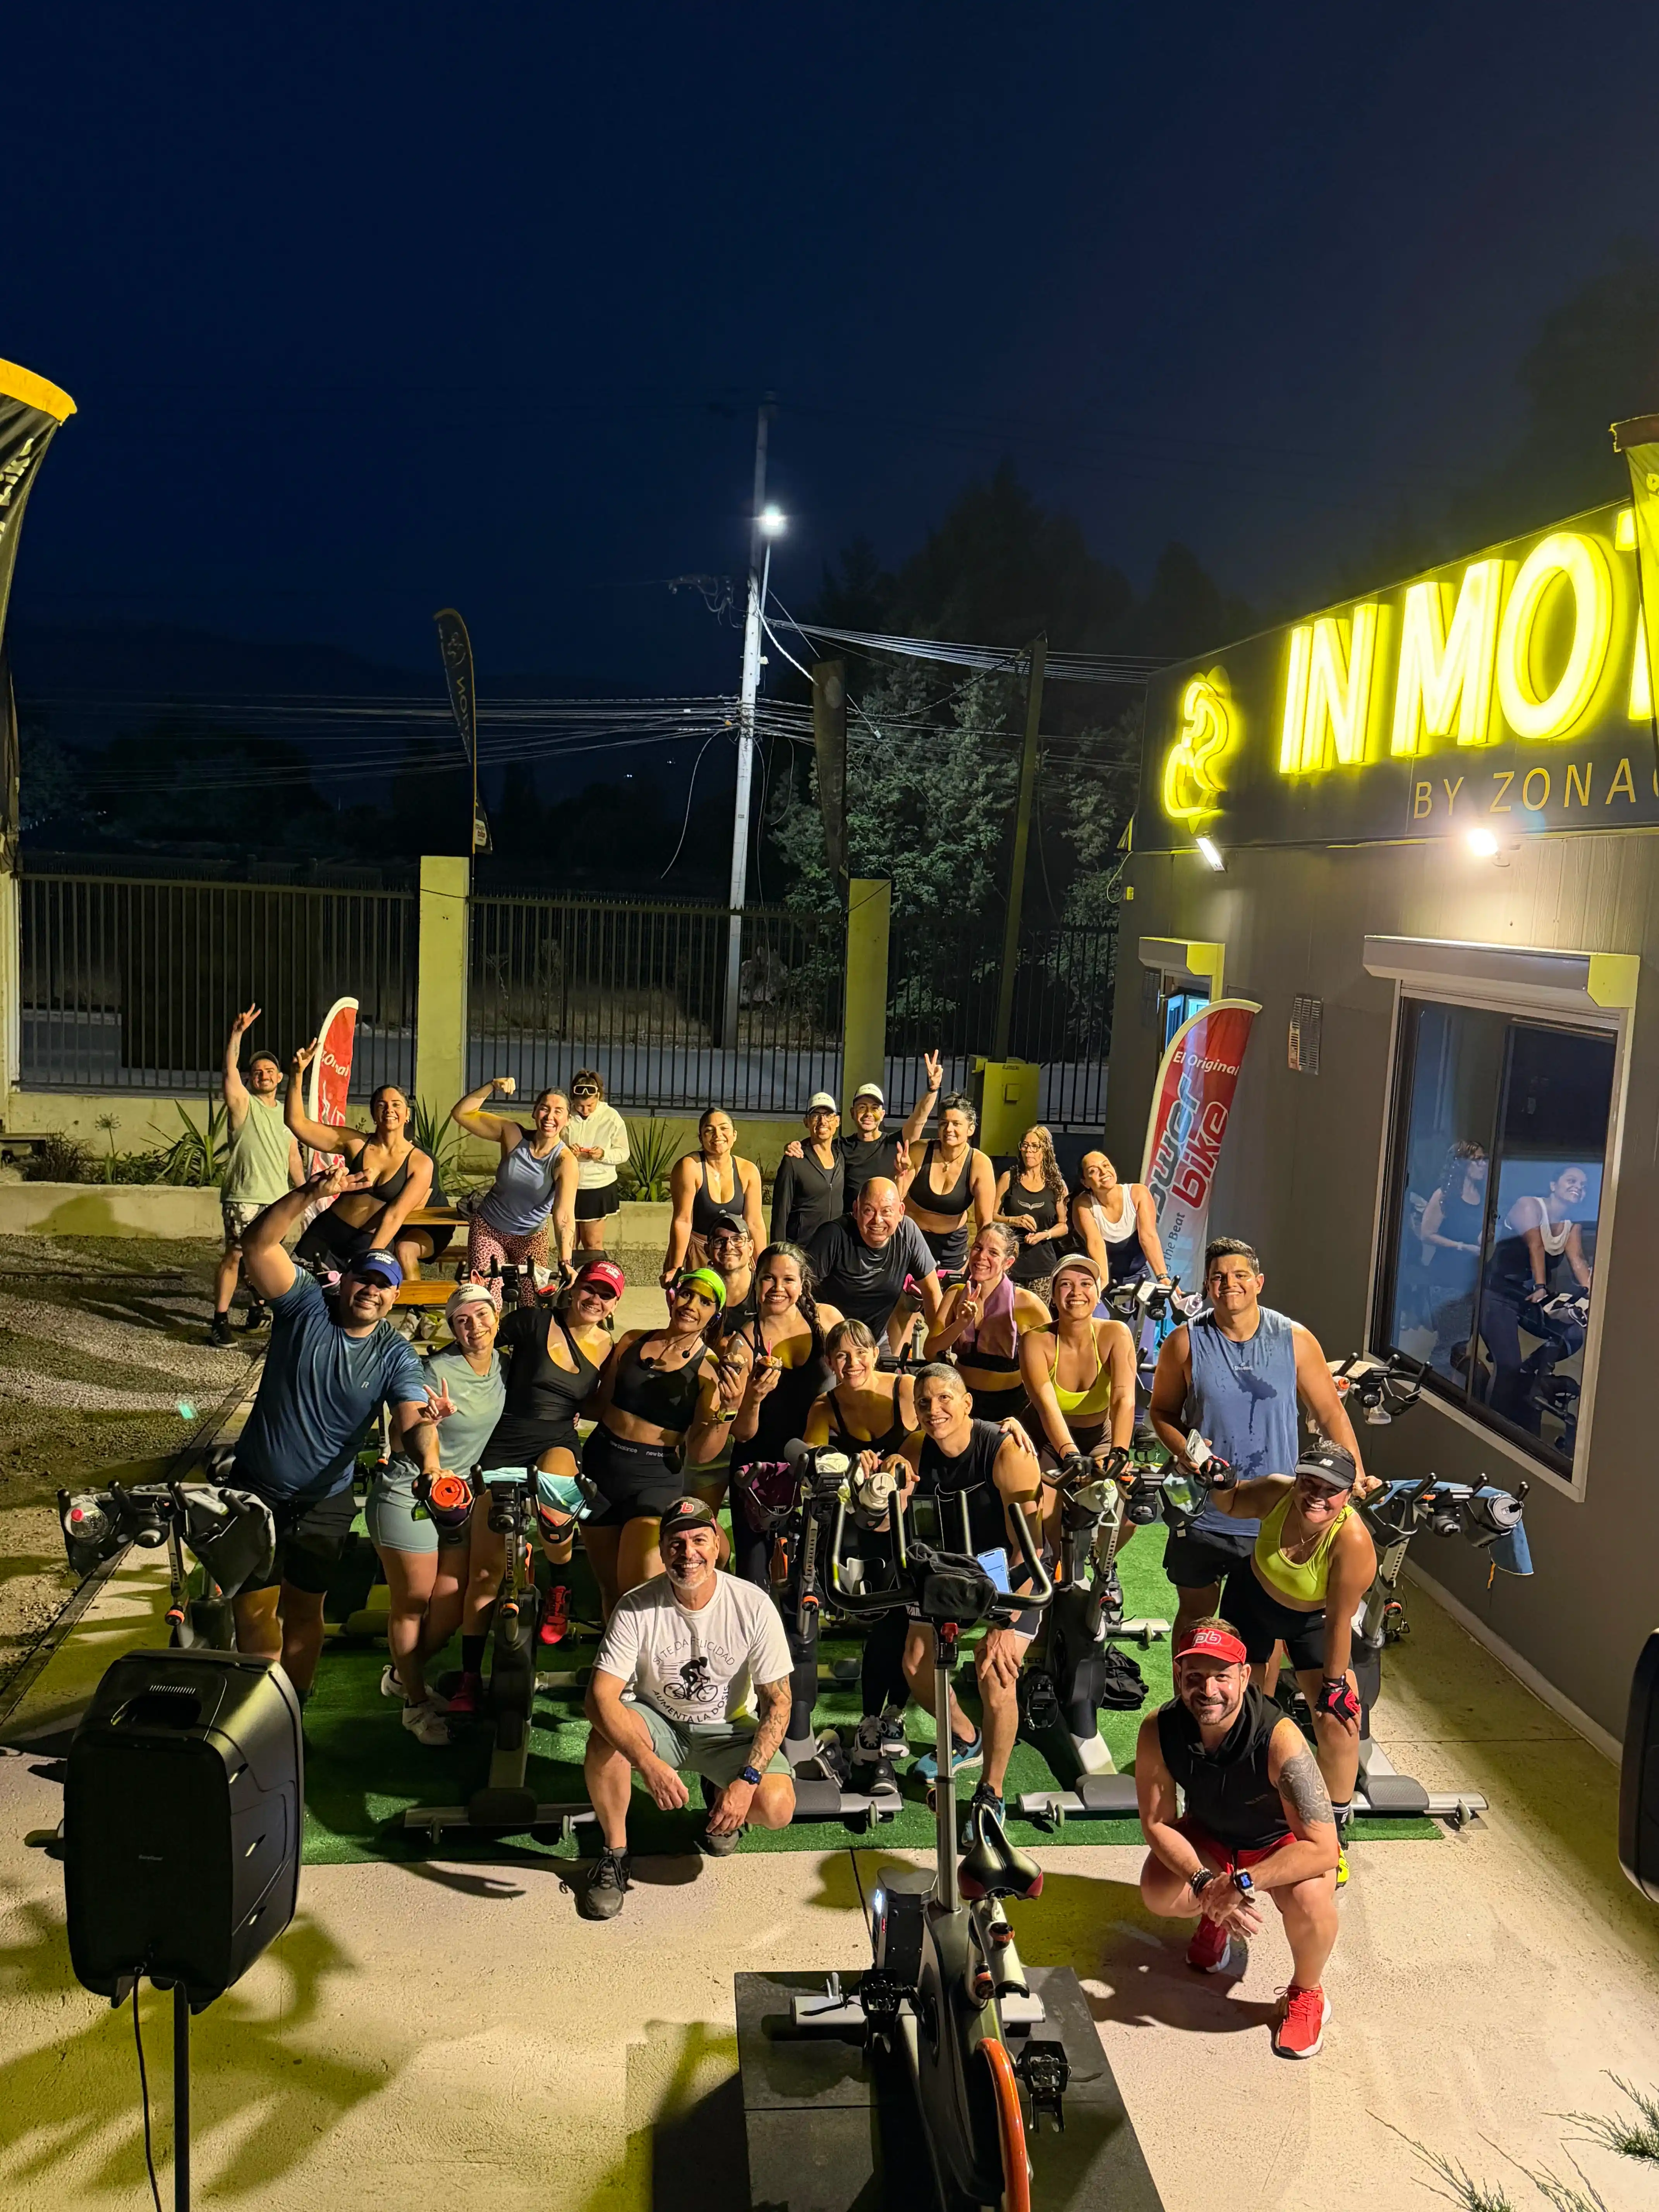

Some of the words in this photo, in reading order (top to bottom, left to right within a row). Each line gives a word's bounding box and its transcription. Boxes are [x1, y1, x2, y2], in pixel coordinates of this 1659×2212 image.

[1279, 603, 1386, 775] IN
[1413, 776, 1464, 819] BY
[1173, 1051, 1186, 1064] El
[1187, 1054, 1239, 1076] Original
[1147, 1072, 1200, 1224] ower
[1169, 1101, 1229, 1211] bike
[1168, 1212, 1185, 1241] Beat
[1163, 1242, 1175, 1260] the
[681, 1501, 694, 1513] b
[653, 1655, 663, 1665] SI
[660, 1645, 674, 1658] TE
[674, 1638, 689, 1651] DA
[690, 1636, 735, 1665] FELICIDAD
[1191, 1630, 1222, 1647] pb
[652, 1690, 694, 1723] AUMENTA
[697, 1713, 711, 1723] LA
[711, 1685, 730, 1715] DOSIS
